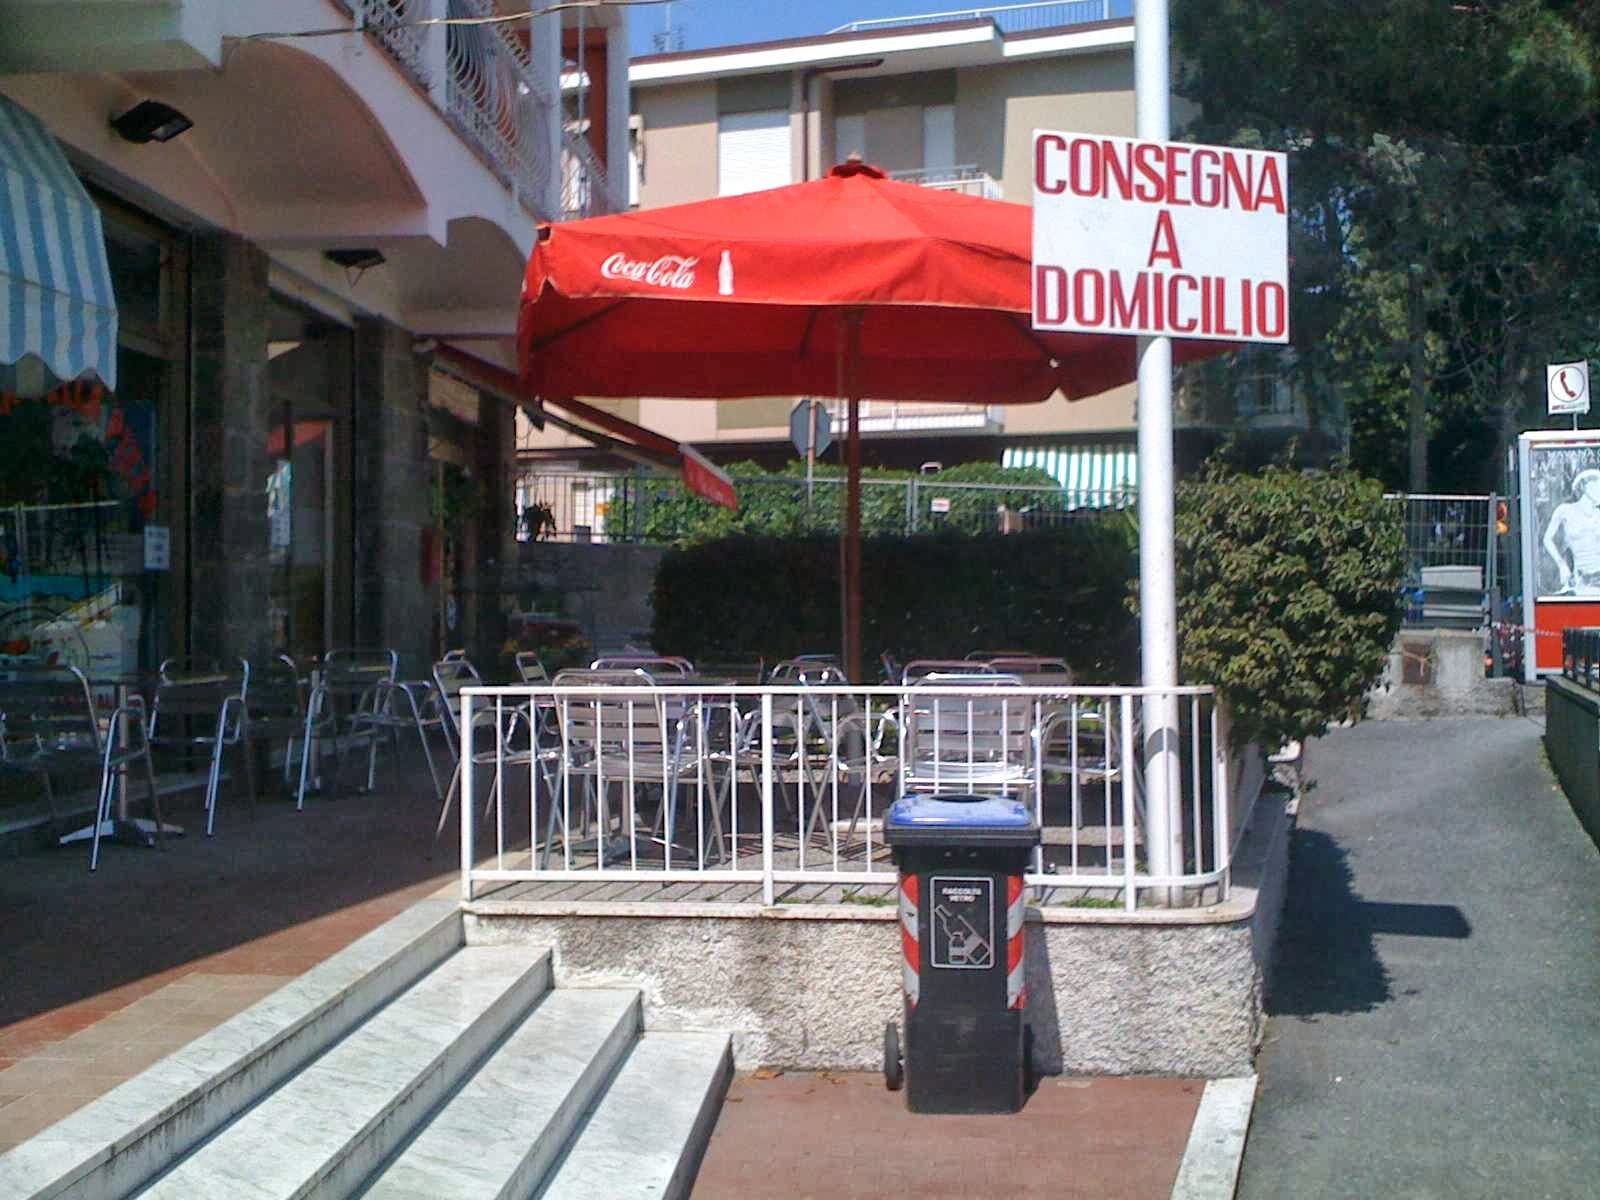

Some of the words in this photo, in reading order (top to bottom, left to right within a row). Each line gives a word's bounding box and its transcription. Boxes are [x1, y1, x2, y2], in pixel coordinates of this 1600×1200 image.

[1035, 134, 1286, 214] CONSEGNA
[601, 251, 700, 289] Coca-Cola
[1147, 209, 1182, 269] A
[1036, 265, 1286, 338] DOMICILIO
